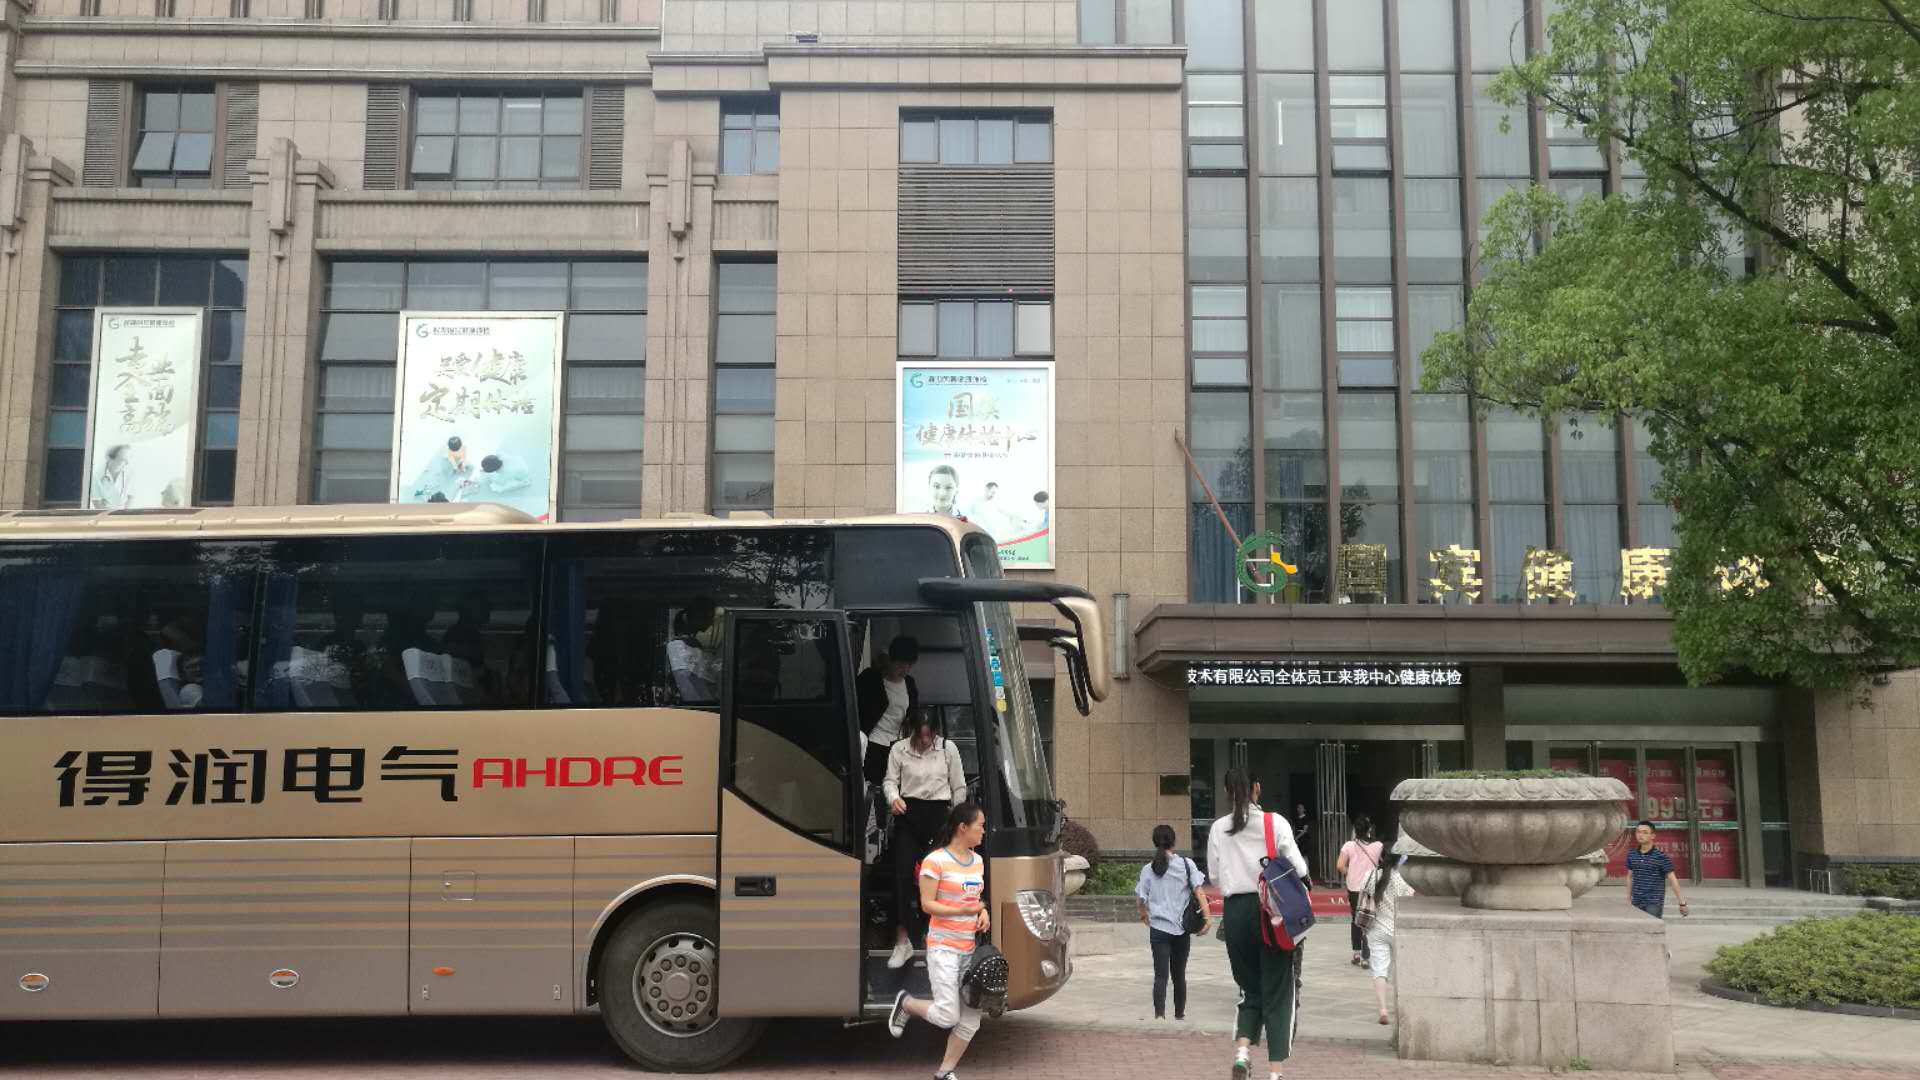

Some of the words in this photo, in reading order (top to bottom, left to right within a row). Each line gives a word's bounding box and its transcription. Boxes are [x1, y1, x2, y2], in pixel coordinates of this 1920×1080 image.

[53, 746, 459, 806] 得润电气
[472, 755, 684, 788] AHDRE
